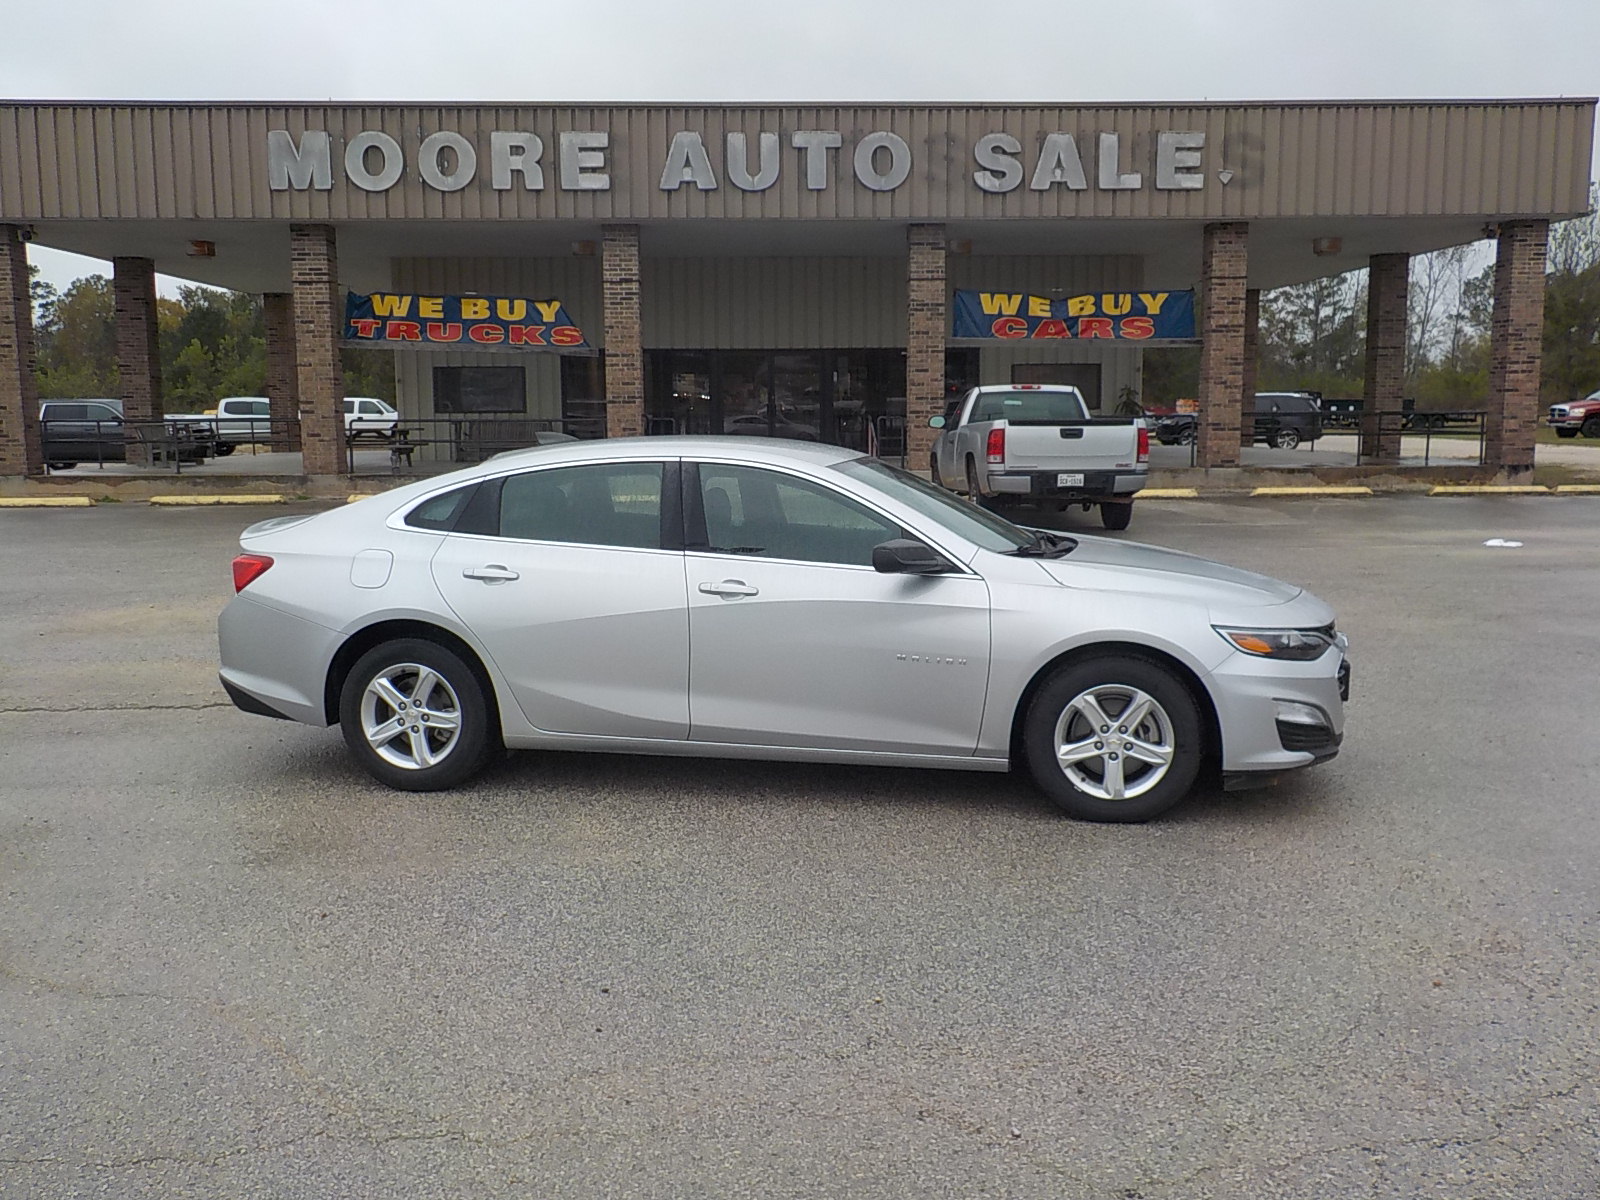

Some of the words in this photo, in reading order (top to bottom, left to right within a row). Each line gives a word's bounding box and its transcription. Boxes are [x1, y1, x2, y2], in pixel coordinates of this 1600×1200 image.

[267, 130, 610, 192] MOORE
[659, 131, 912, 192] AUTO
[973, 131, 1206, 193] SALE
[370, 294, 445, 318] WE
[461, 298, 561, 323] BUY
[979, 293, 1052, 317] WE
[1067, 293, 1170, 317] BUY
[351, 319, 584, 346] TRUCKS
[991, 317, 1155, 339] CARS
